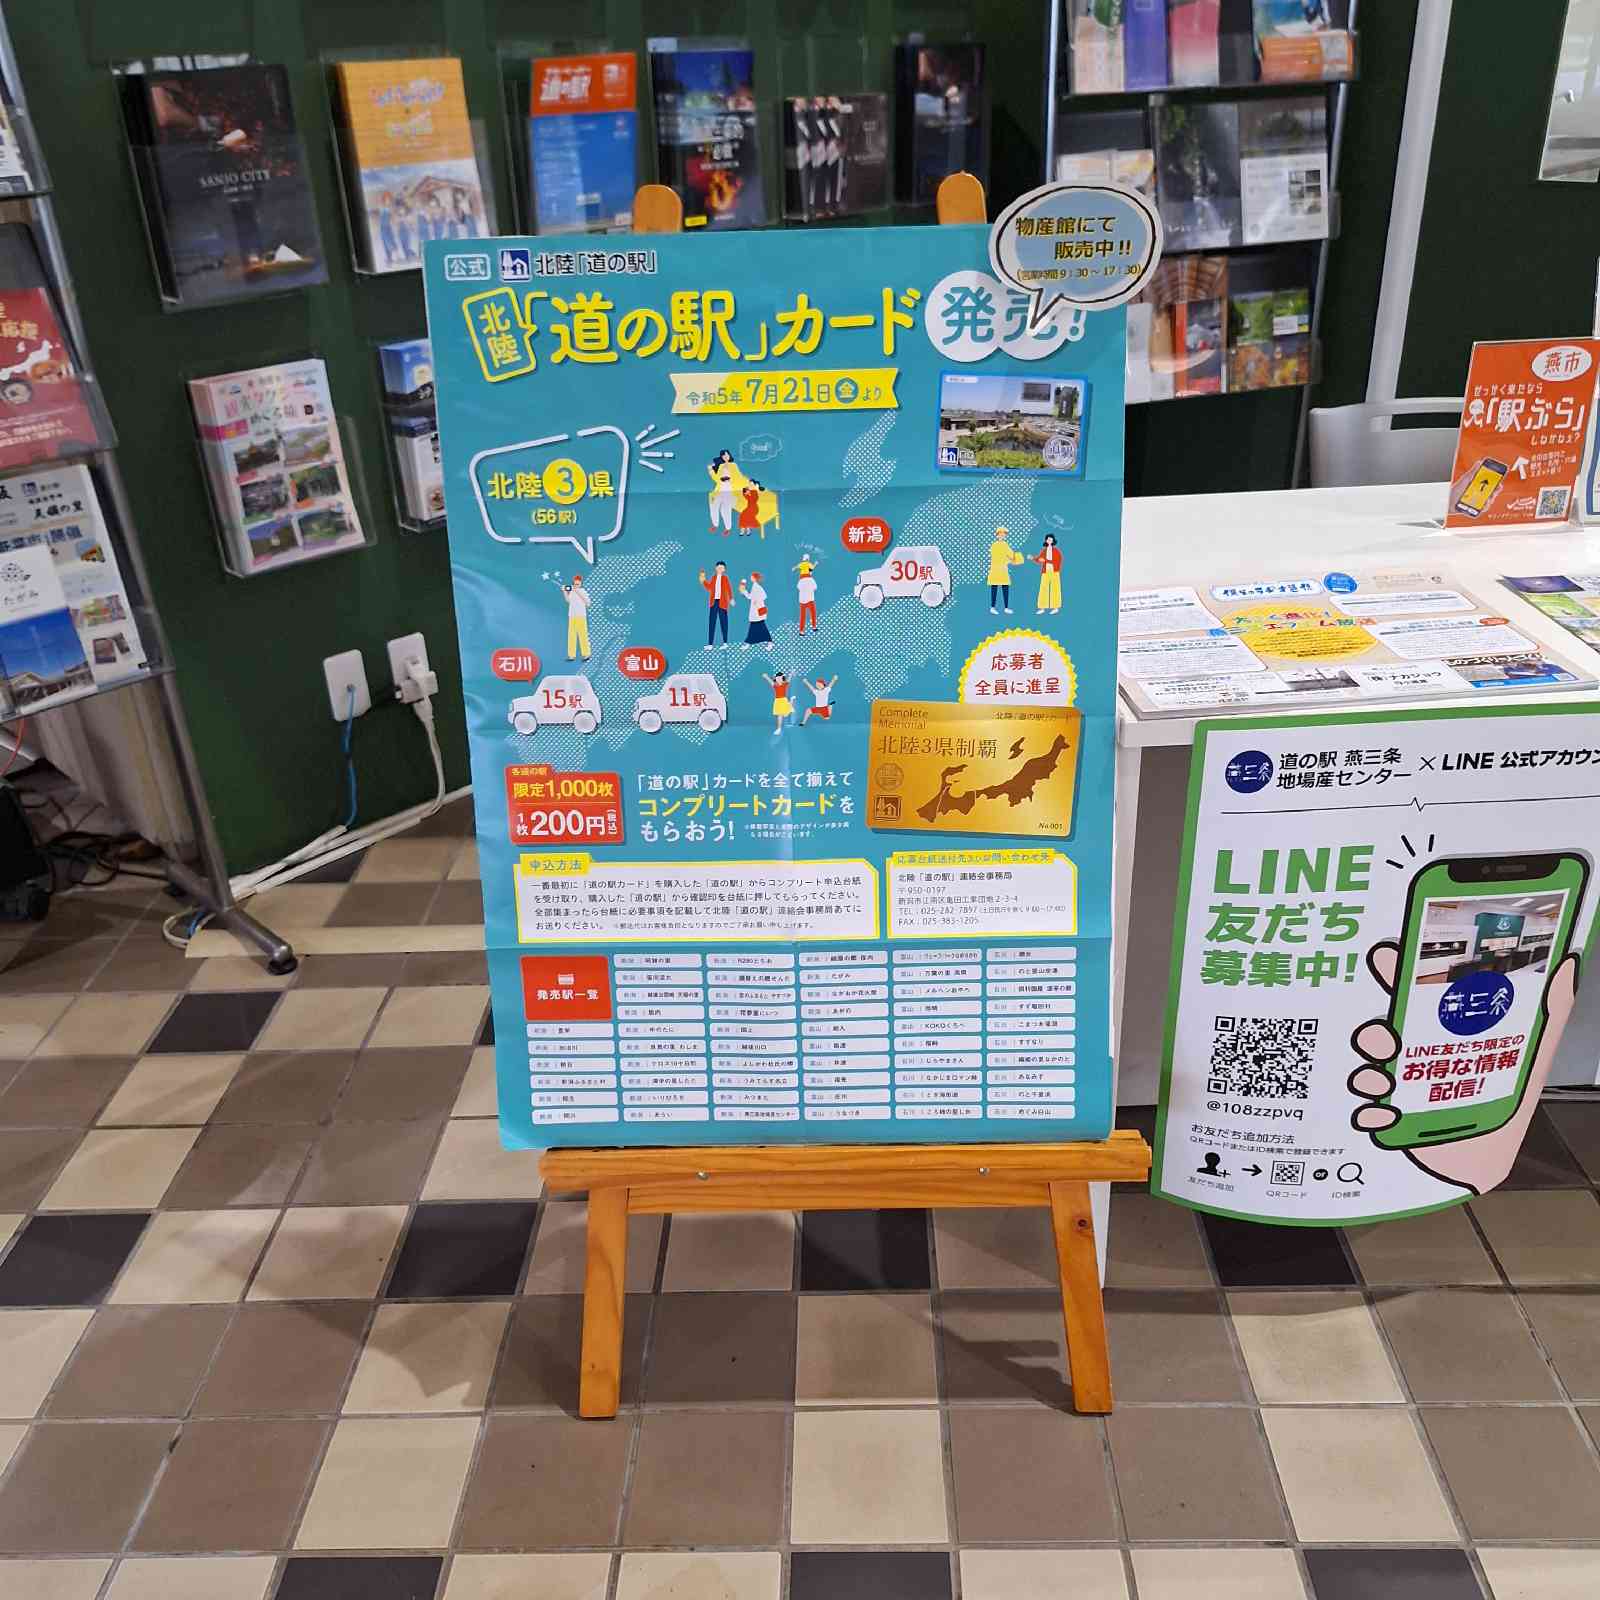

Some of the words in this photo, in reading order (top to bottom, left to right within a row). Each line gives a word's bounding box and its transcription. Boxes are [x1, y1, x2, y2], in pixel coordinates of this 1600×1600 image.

[1016, 215, 1118, 236] 物産館にて
[1054, 240, 1132, 261] 販売中!!
[449, 258, 487, 277] 公式
[536, 251, 658, 275] 北陸「道の駅」
[479, 302, 522, 368] 北陸
[524, 287, 921, 364] 「道の駅」カード
[1543, 351, 1582, 376] 燕市
[488, 466, 615, 502] 北陸3県
[531, 509, 578, 525] (56駅)
[848, 526, 884, 544] 新潟
[890, 560, 934, 582] 30駅
[499, 656, 533, 673] 石川
[625, 655, 660, 672] 富山
[990, 653, 1045, 671] 応募者
[669, 687, 707, 707] 11駅
[975, 678, 1062, 697] 全員に進呈
[542, 689, 584, 709] 15駅
[879, 708, 928, 719] Complete
[877, 736, 998, 758] 北陸3県制覇
[1279, 750, 1338, 770] 道の駅
[1344, 747, 1402, 766] 燕三条
[1441, 751, 1495, 771] LINE
[513, 780, 615, 799] 限定1,000枚
[637, 771, 854, 792] 「道の駅」カードを全て揃えて
[1277, 769, 1412, 790] 地場産センター
[638, 792, 855, 818] コンプリートカードを
[530, 809, 606, 837] 200円
[641, 820, 735, 842] もらおう!
[529, 859, 583, 872] 申込方法
[1213, 845, 1376, 895] LINE
[1204, 902, 1366, 945] 友だち
[1200, 949, 1360, 988] 募集中!
[536, 989, 600, 1002] 発売駅一覧
[1405, 1034, 1526, 1058] LINE友だち限定の
[1402, 1049, 1521, 1082] お得な情報
[1428, 1077, 1486, 1103] 配信!
[1207, 1101, 1304, 1121] @108zzpvq
[1191, 1124, 1296, 1145] お友だち追加方法
[1190, 1135, 1346, 1156] QRコードまたはID検索で登録できます
[1187, 1176, 1235, 1193] 友だち追加
[1315, 1171, 1327, 1179] or
[1266, 1190, 1308, 1199] QRコード
[1331, 1190, 1361, 1199] ID検索
